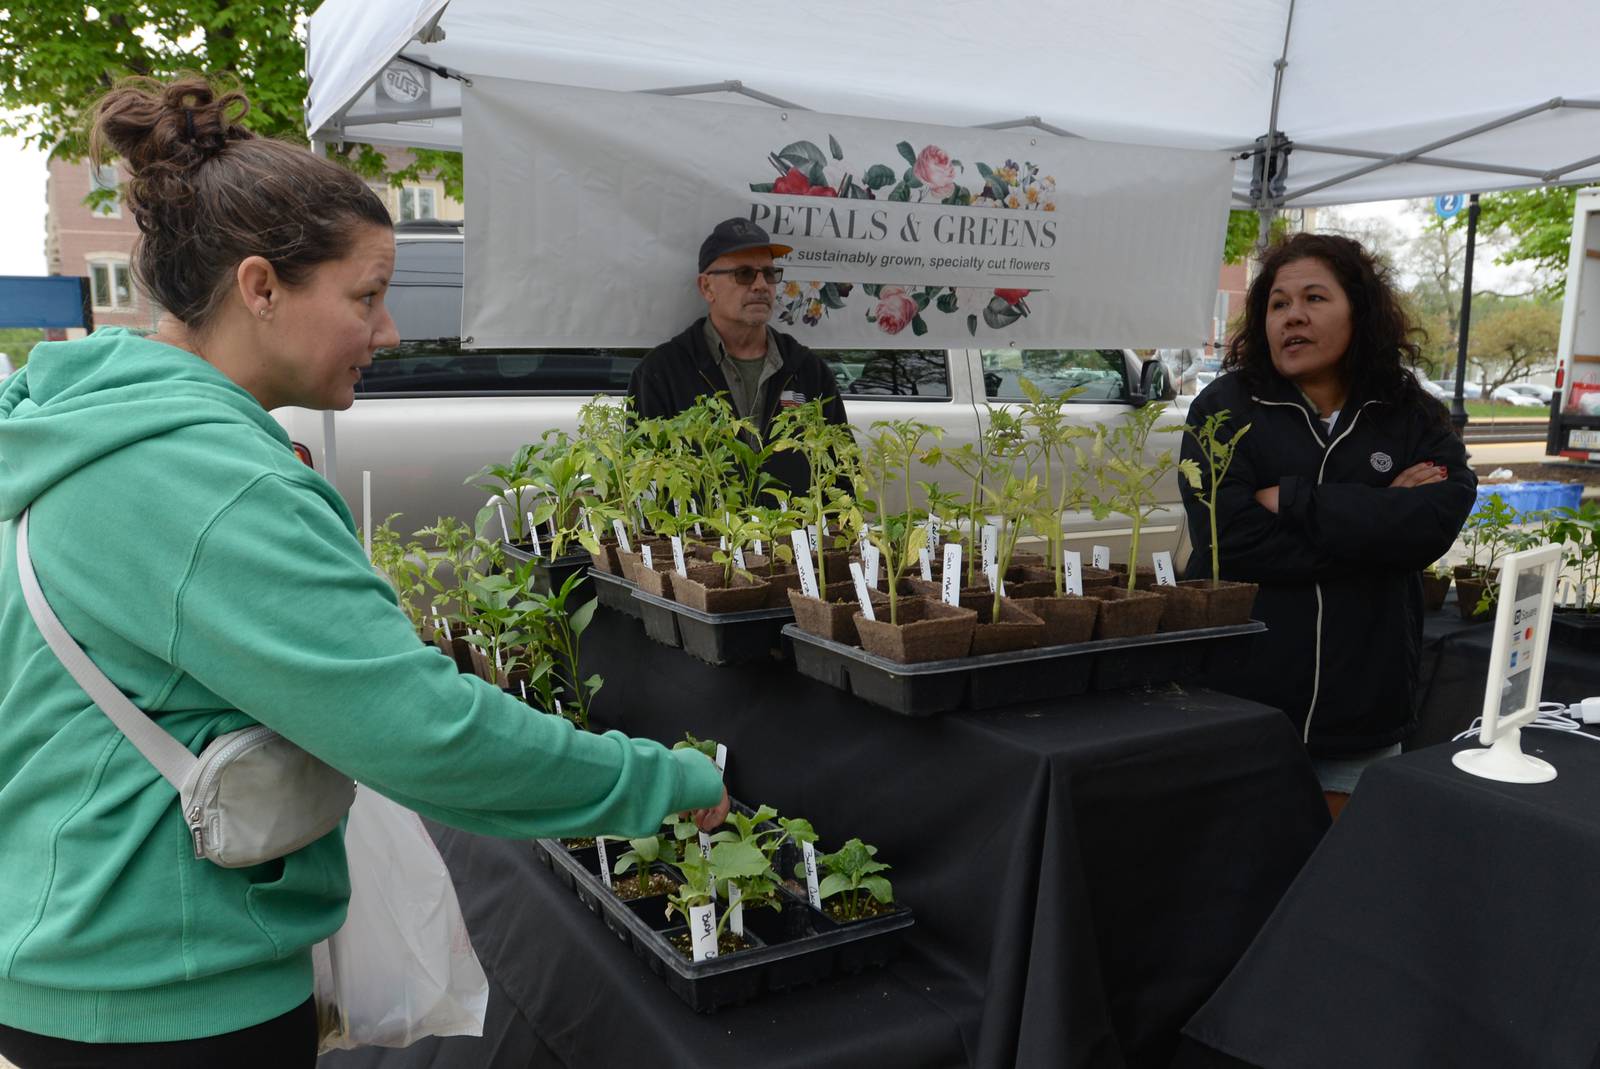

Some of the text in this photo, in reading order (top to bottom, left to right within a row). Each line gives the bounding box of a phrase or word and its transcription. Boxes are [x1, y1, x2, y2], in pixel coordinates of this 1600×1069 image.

[1444, 194, 1454, 210] 2
[750, 203, 888, 241] PETALS
[900, 212, 920, 242] &
[933, 214, 1057, 249] GREENS
[798, 250, 877, 267] sustainably
[880, 255, 925, 267] grown,
[929, 256, 985, 271] specialty
[987, 258, 1006, 269] cut
[1009, 258, 1050, 271] flowers
[700, 910, 714, 941] Bush
